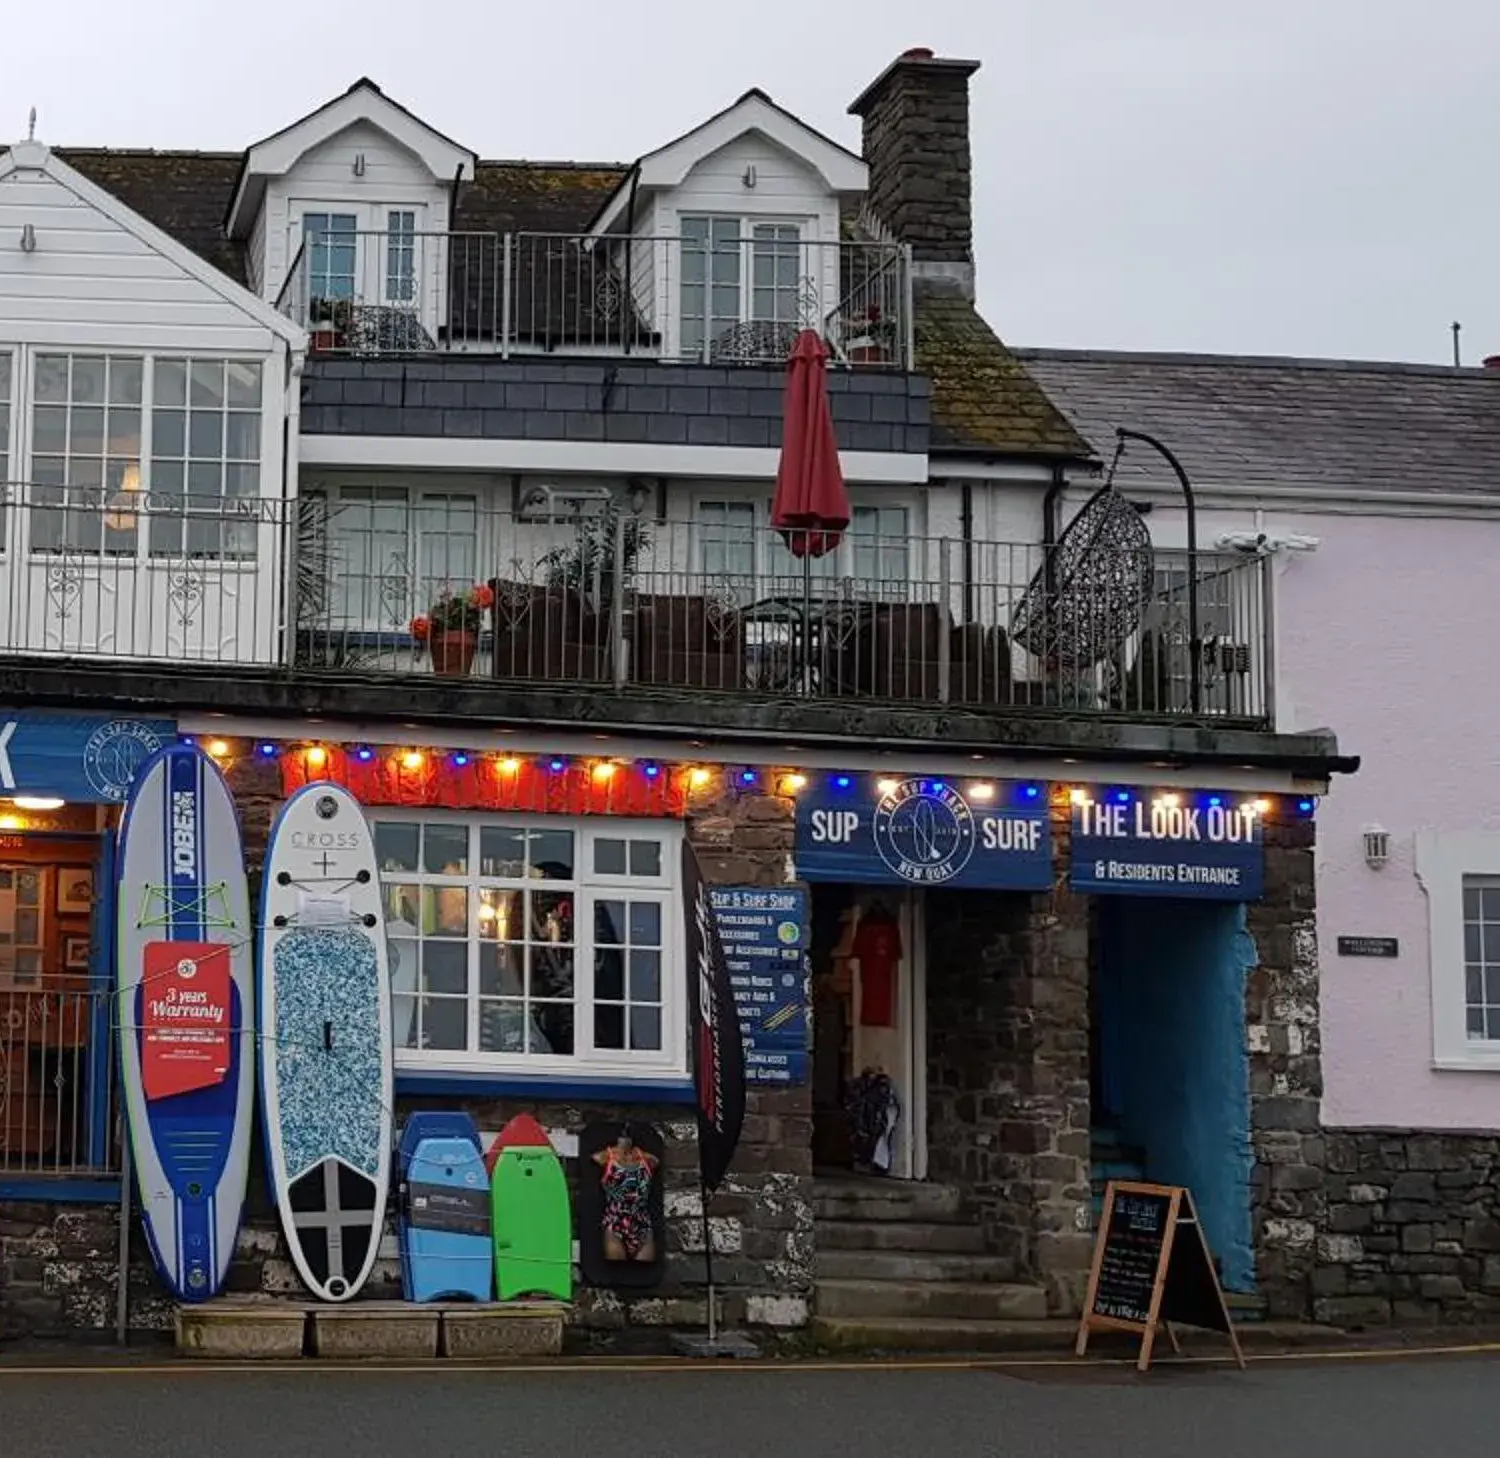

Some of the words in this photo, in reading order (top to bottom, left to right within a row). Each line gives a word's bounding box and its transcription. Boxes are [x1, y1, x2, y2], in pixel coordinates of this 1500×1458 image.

[812, 810, 859, 842] SUP
[982, 817, 1043, 851] SURF
[1081, 799, 1127, 836] THE
[1135, 801, 1201, 841] LOOK
[1208, 805, 1259, 843] OUT
[173, 814, 195, 880] JOBE
[291, 831, 360, 847] CROSS
[899, 861, 923, 880] NEW
[925, 862, 954, 881] QUAY
[1095, 860, 1105, 878] &
[1109, 861, 1175, 882] RESIDENTS
[1178, 863, 1241, 885] ENTRANCE
[711, 891, 730, 908] SUP
[166, 987, 177, 1002] 3
[179, 990, 209, 1005] years
[148, 1000, 224, 1023] Warranty
